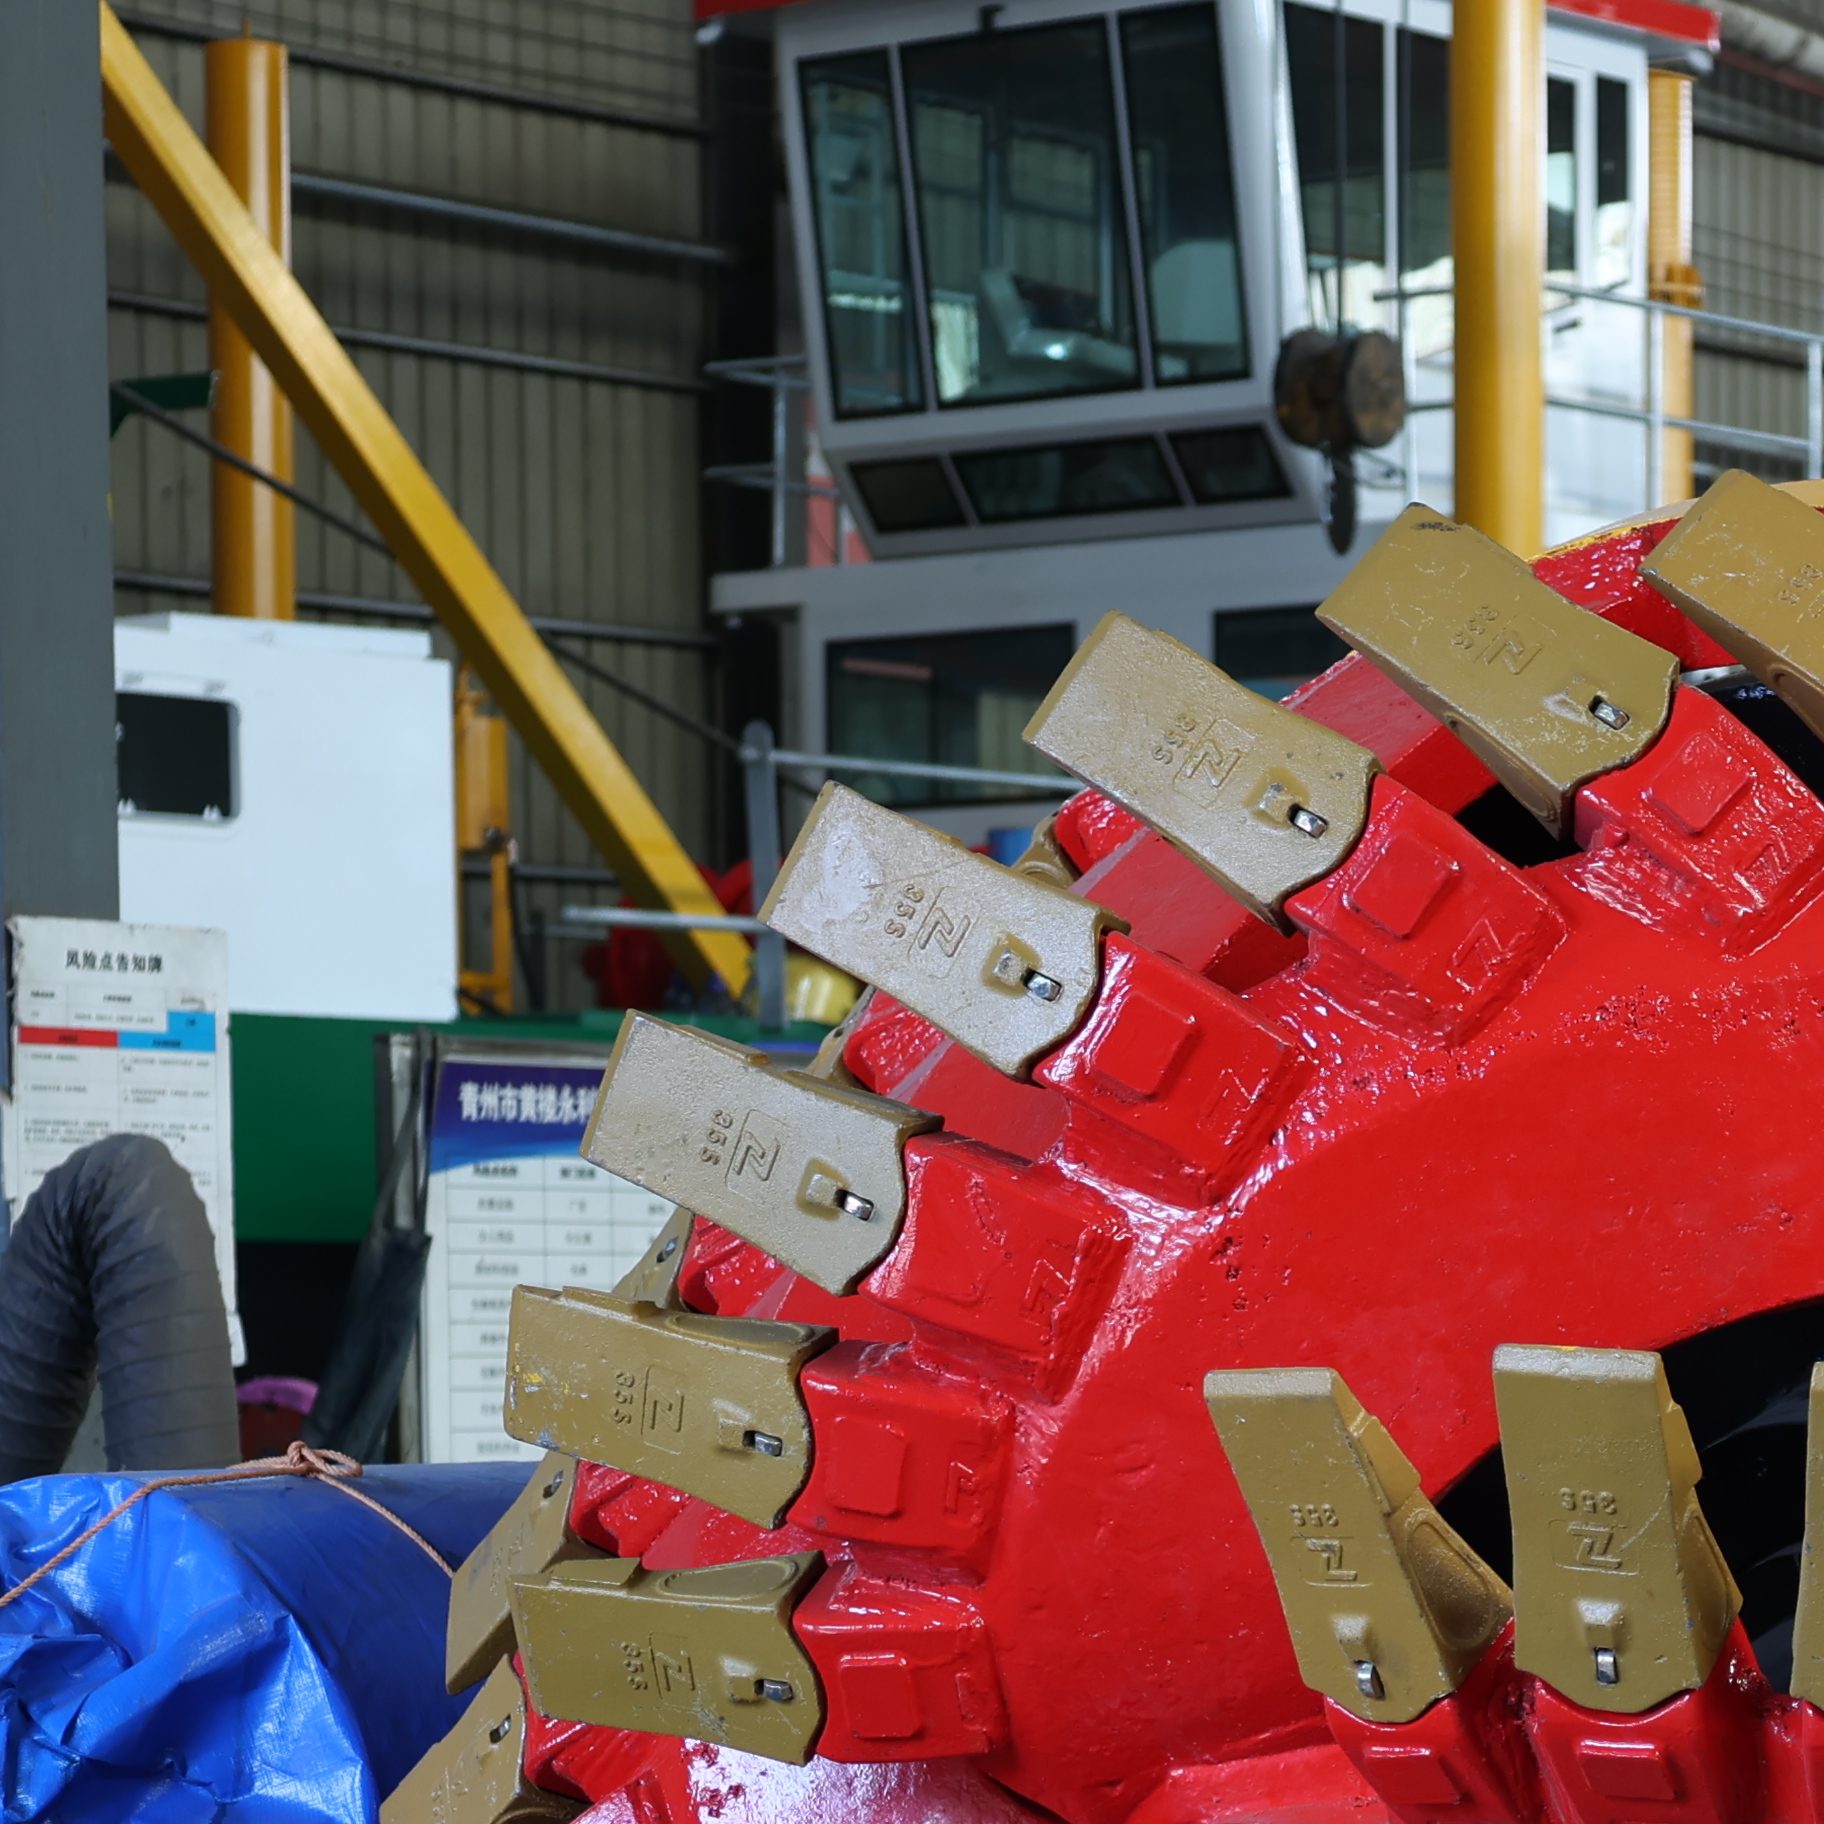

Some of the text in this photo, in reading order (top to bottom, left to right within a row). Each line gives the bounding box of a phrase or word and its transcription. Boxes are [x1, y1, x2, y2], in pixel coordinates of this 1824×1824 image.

[884, 884, 926, 939] 35S
[700, 1109, 734, 1167] 35S
[613, 1370, 636, 1426] 35S
